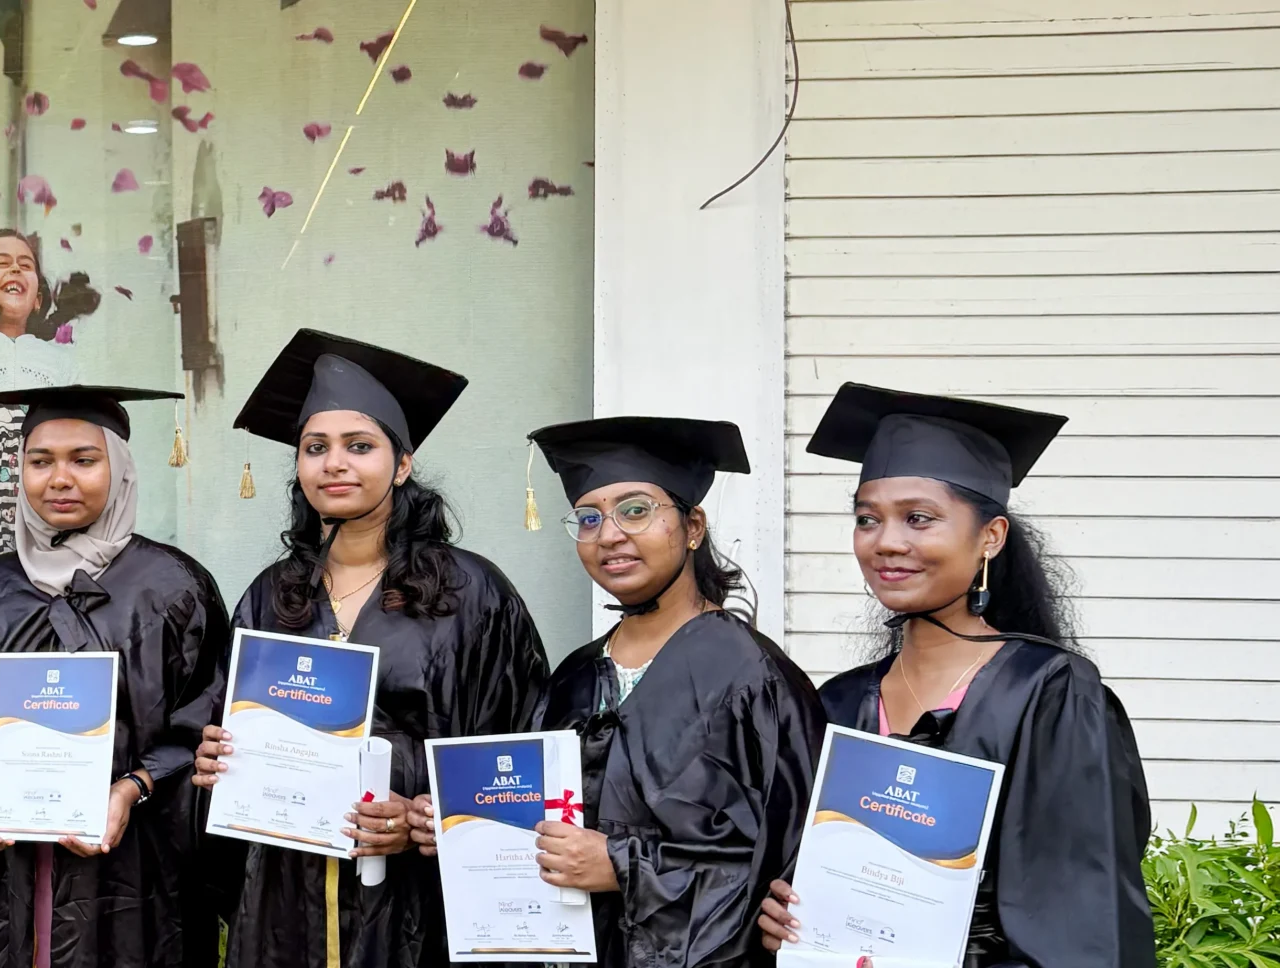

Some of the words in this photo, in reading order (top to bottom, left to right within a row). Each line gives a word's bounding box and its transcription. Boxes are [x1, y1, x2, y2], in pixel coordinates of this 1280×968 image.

[287, 674, 318, 686] ABAT
[40, 686, 65, 695] ABAT
[268, 685, 333, 705] Certificate
[23, 699, 80, 710] Certificate
[492, 775, 522, 787] ABAT
[474, 791, 542, 805] Certificate
[884, 785, 920, 802] ABAT
[859, 795, 936, 827] Certificate
